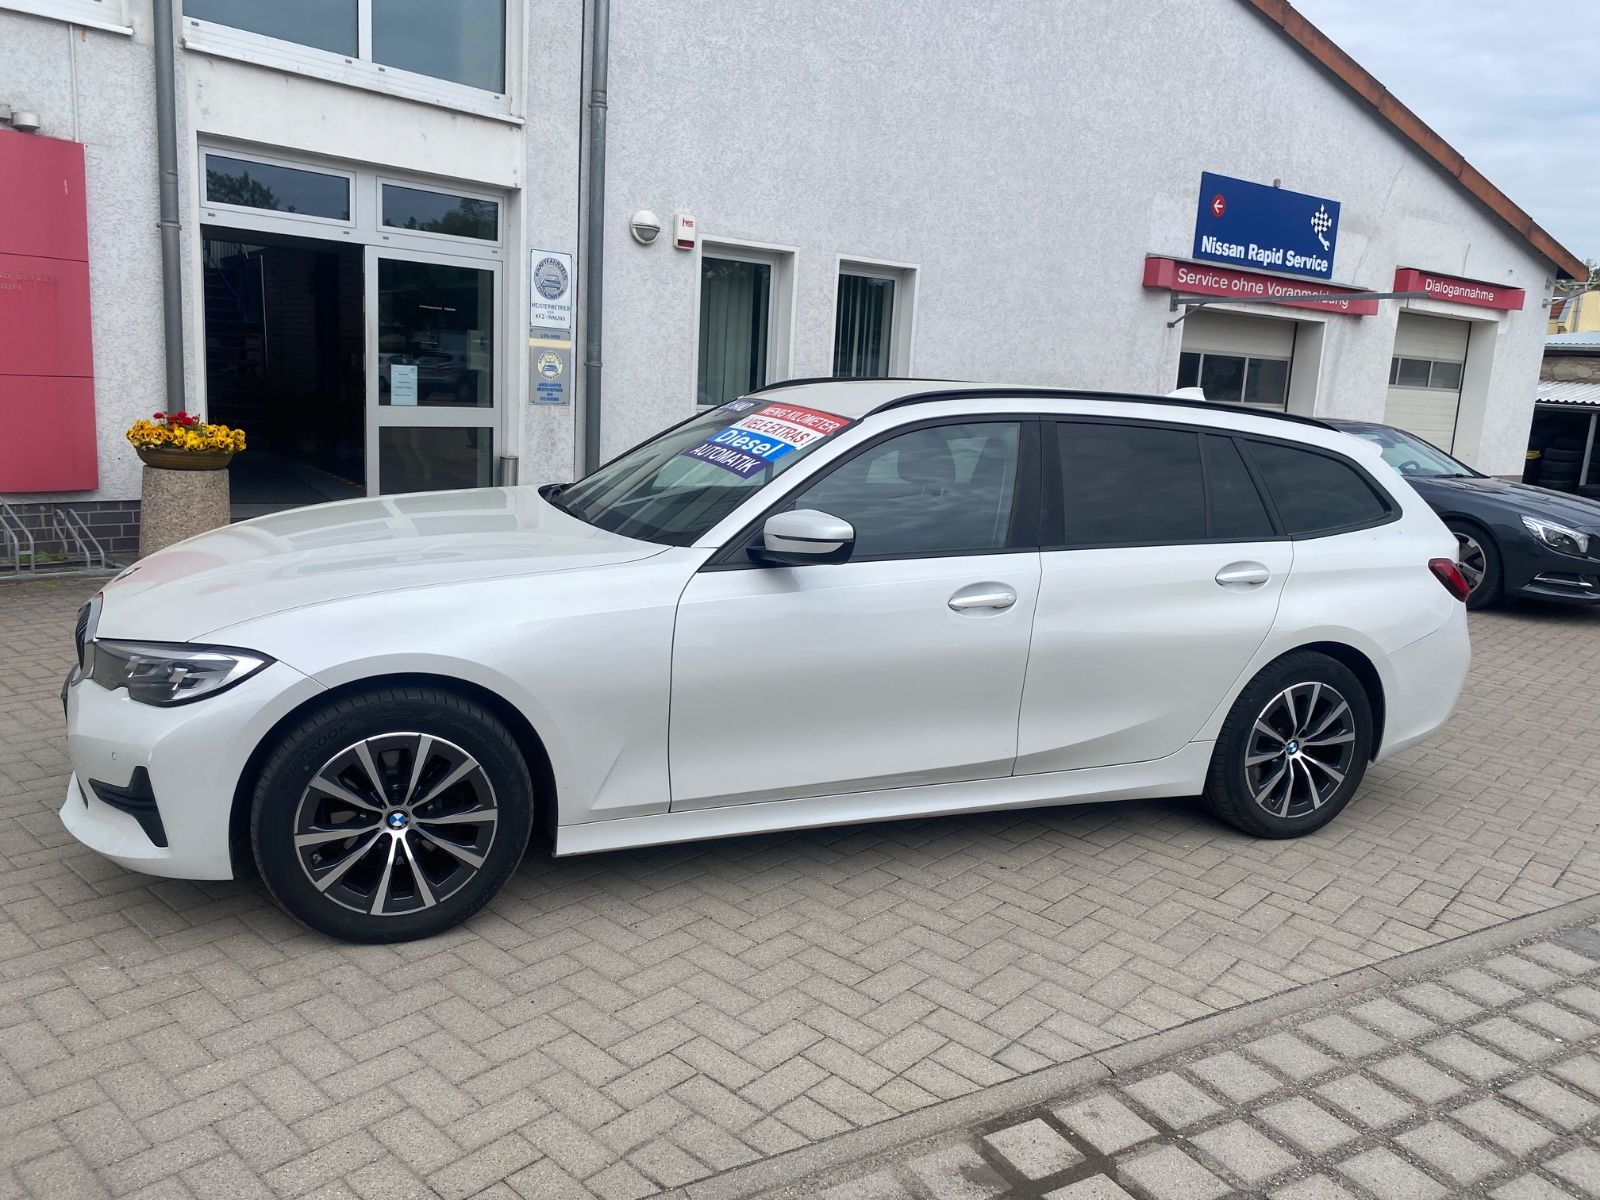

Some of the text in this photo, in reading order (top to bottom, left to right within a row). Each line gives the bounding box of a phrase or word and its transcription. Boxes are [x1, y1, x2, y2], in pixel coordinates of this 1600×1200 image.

[1201, 235, 1329, 273] Nissan Rapid Service
[1177, 268, 1228, 289] Service
[1231, 277, 1264, 295] ohne
[1425, 278, 1495, 302] Dialogannahme
[765, 421, 811, 443] EXTRAS
[787, 409, 841, 433] KILOMETER
[714, 429, 784, 458] Diesel
[689, 443, 760, 474] AUTOMATIK
